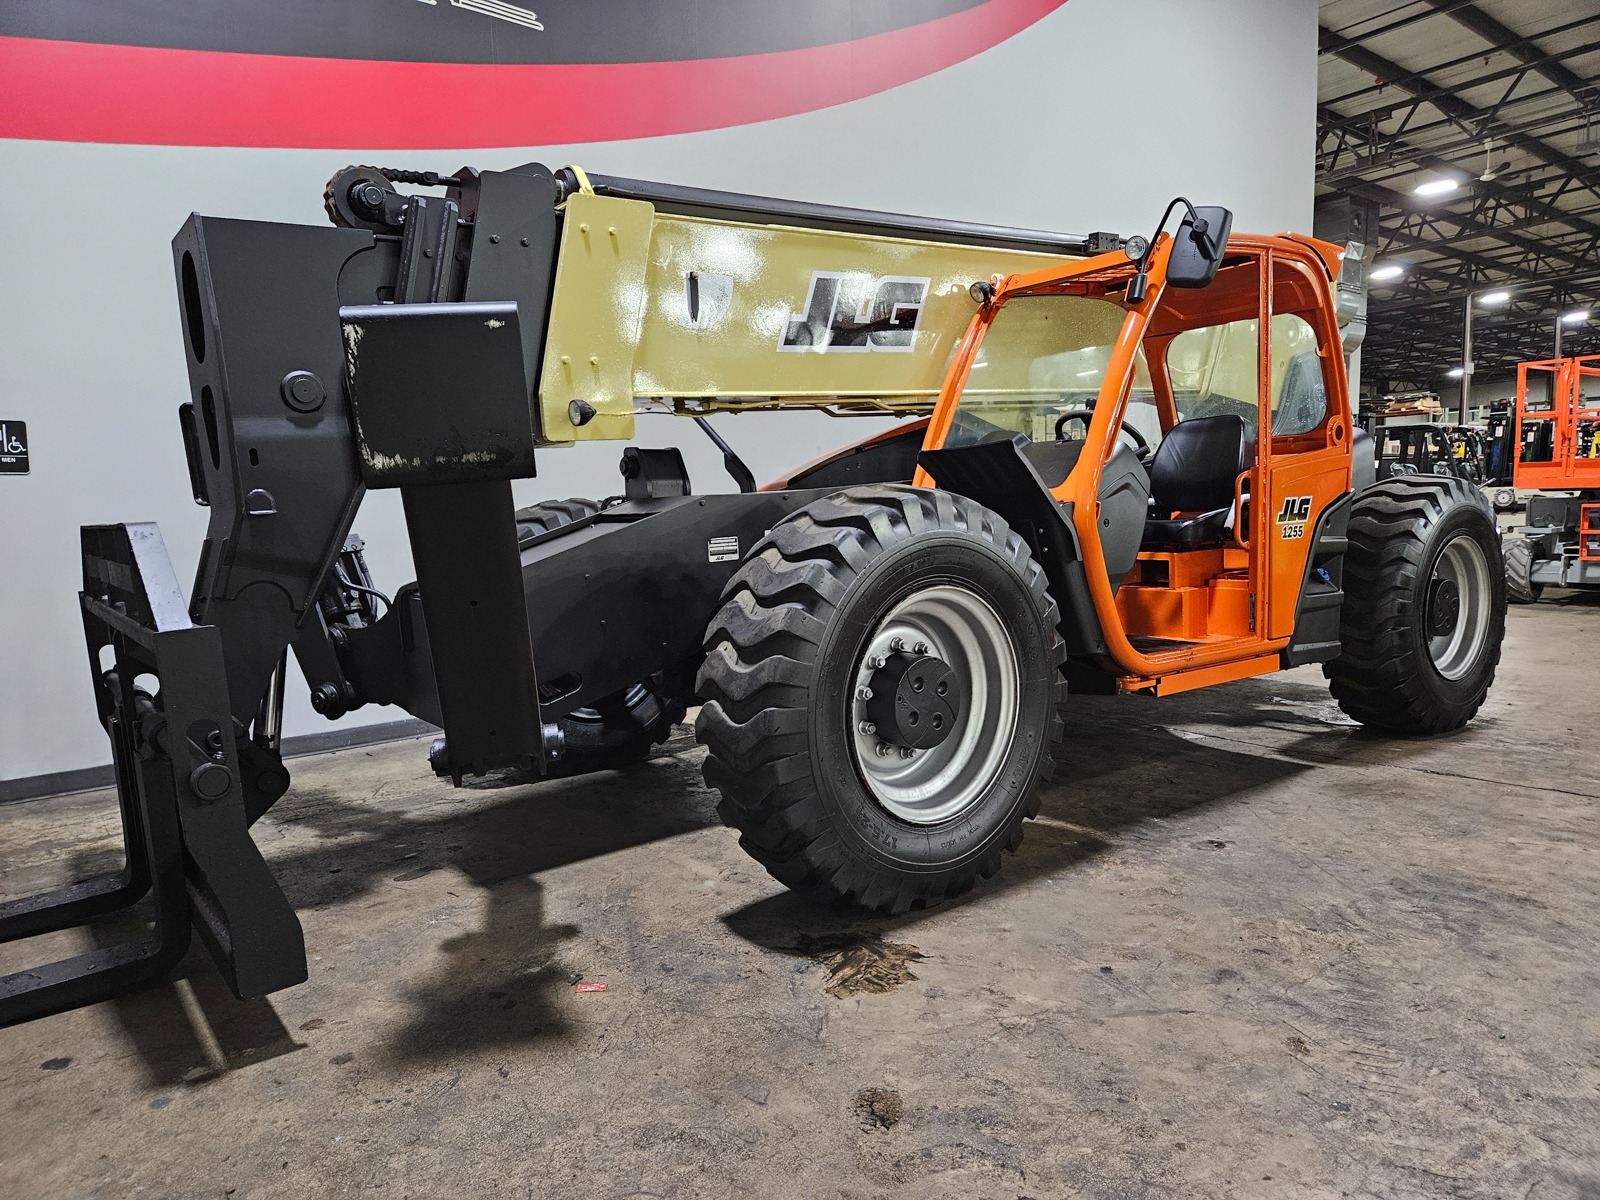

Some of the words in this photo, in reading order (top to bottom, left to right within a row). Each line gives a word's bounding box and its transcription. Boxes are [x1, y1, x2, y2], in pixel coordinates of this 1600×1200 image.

[776, 270, 931, 352] JLG
[1276, 496, 1313, 524] JLG
[1281, 524, 1304, 540] 1255
